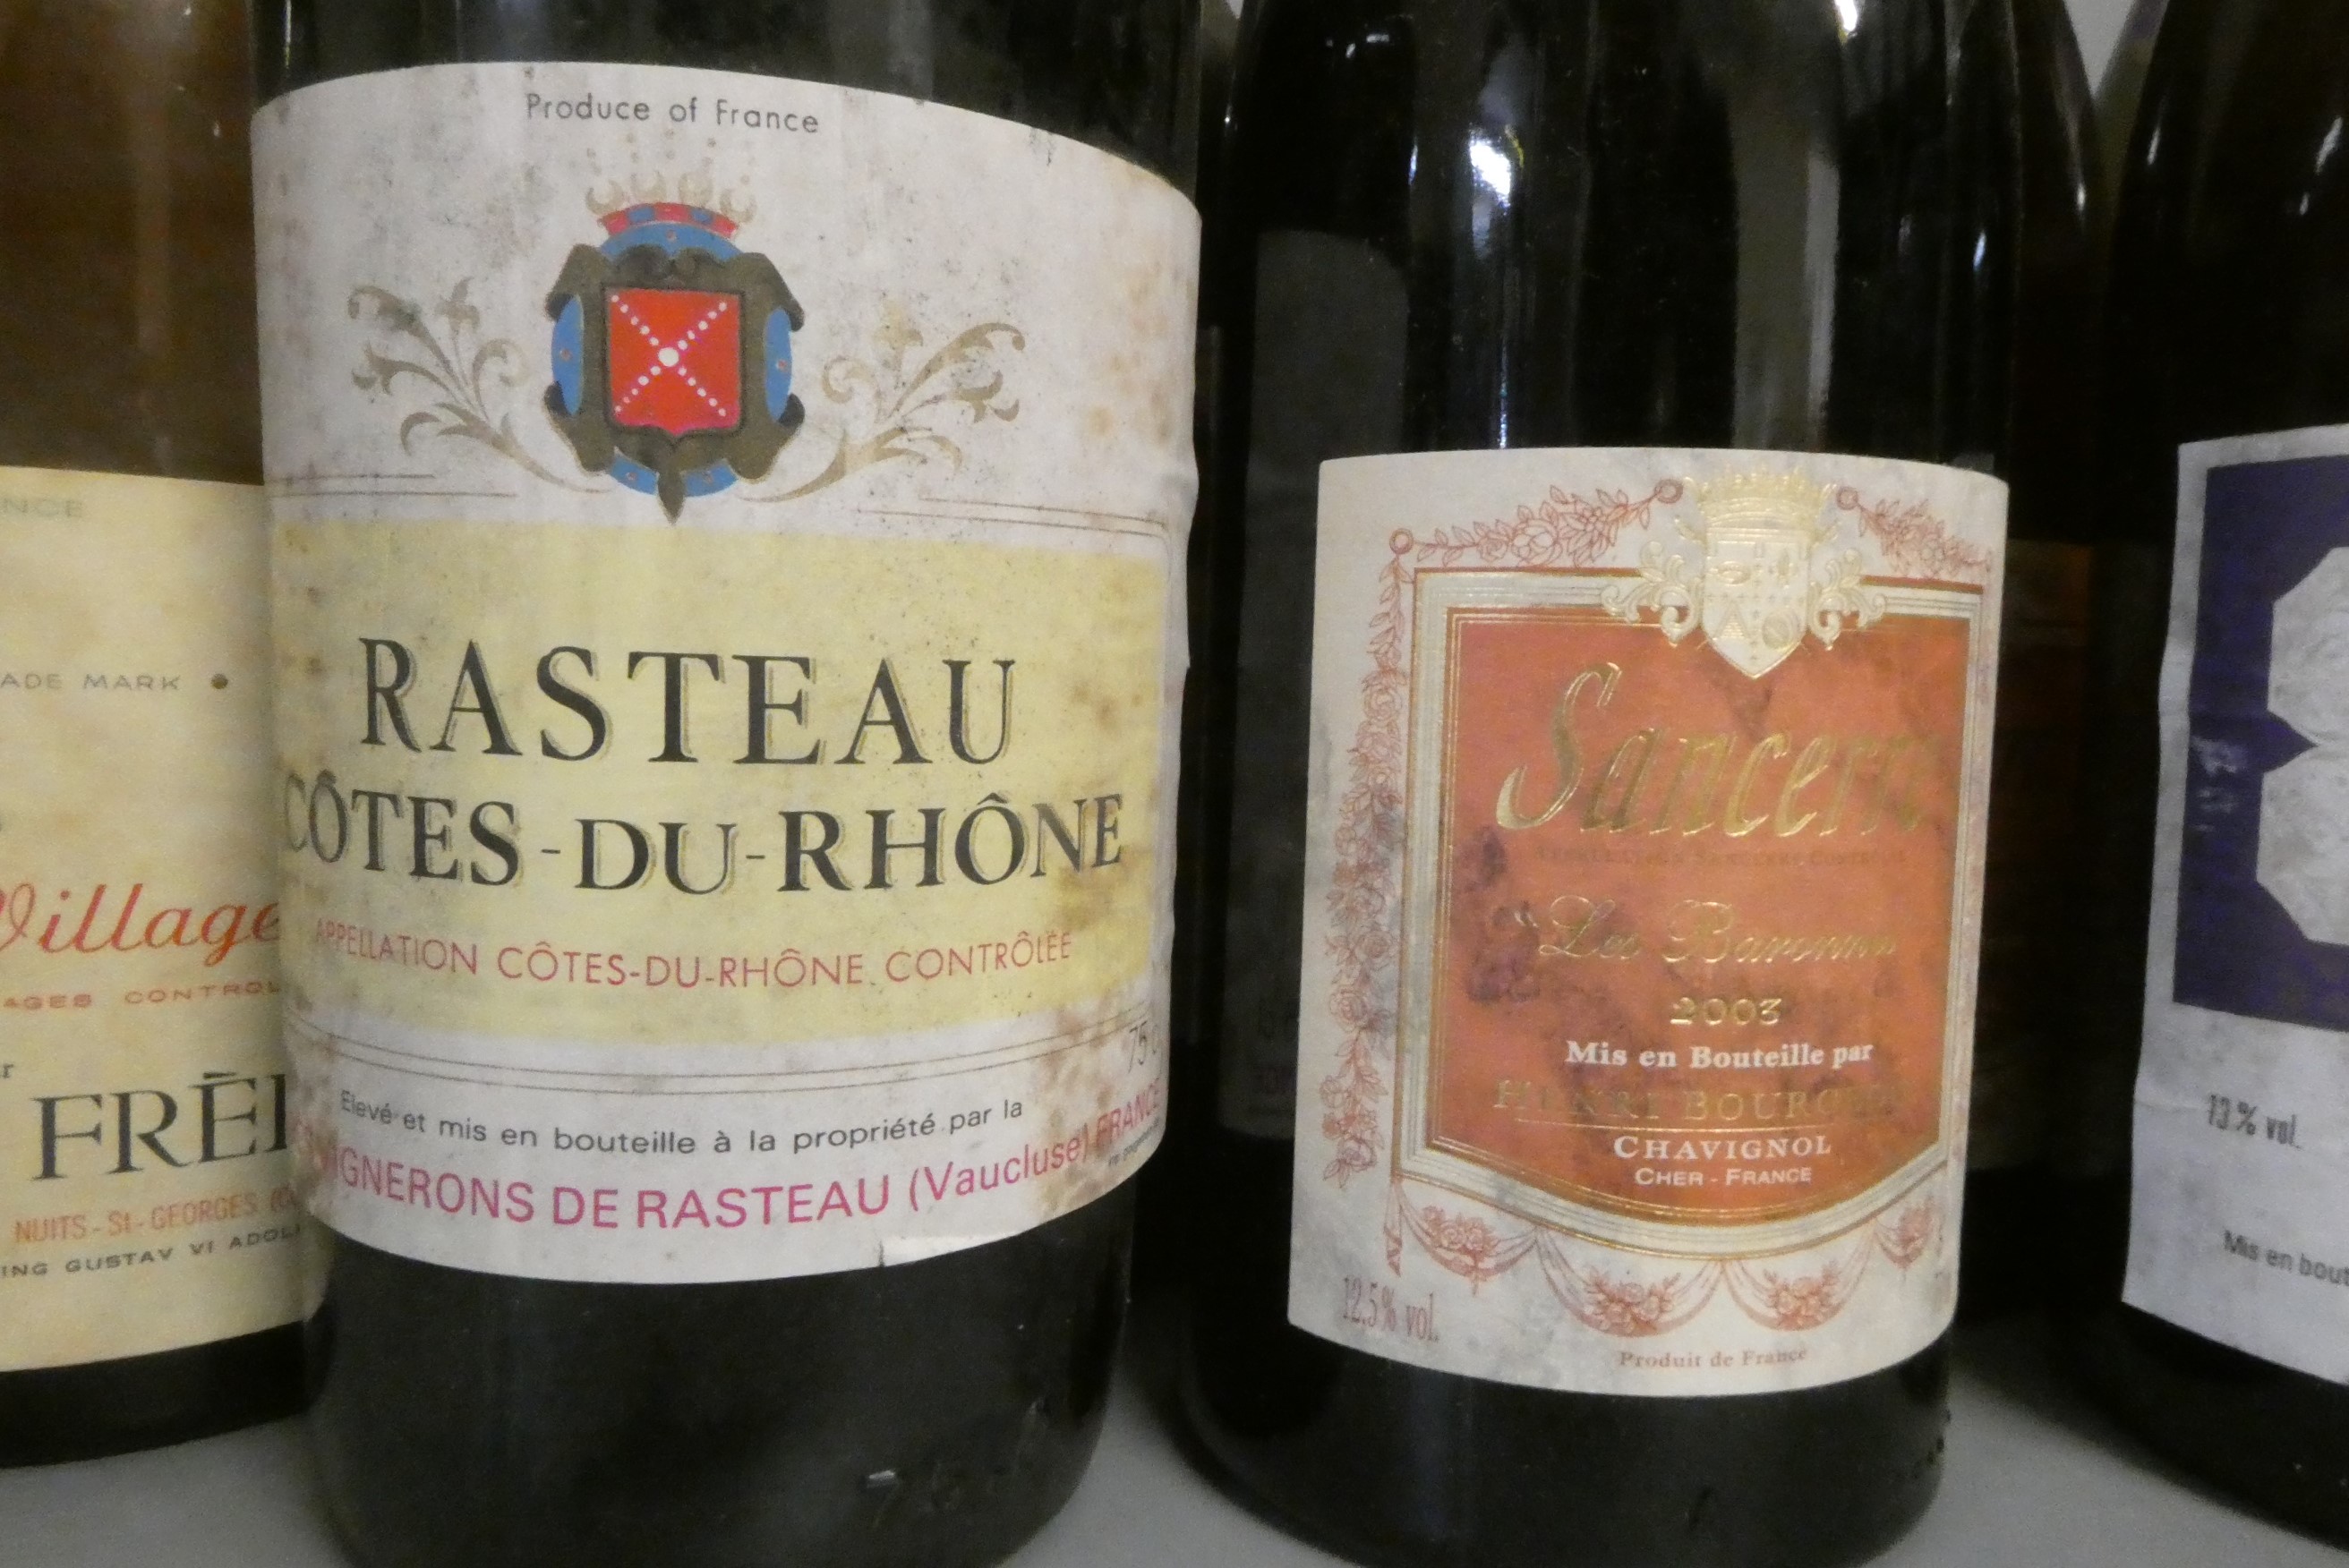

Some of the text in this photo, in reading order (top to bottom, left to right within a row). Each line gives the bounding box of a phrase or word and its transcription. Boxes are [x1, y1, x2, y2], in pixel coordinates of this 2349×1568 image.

[526, 93, 819, 133] Produce of France
[82, 673, 181, 692] MARK
[359, 637, 1015, 766] RASTEAU
[316, 918, 1072, 988] APPELLATION CÔTES-DU-RHÔNE CONTRÔLÉE
[1670, 995, 1783, 1027] 2003
[1566, 1039, 1874, 1070] Mis en Bouteille par
[341, 1089, 1023, 1155] Elevé et mis en bouteille à la propriété par la
[1613, 1134, 1832, 1162] CHAVIGNOL
[552, 1185, 619, 1230] DE
[636, 1172, 889, 1230] RASTEAU
[64, 1247, 174, 1273] GUSTAV
[189, 1240, 215, 1256] VI
[2266, 1248, 2293, 1271] en
[1619, 1346, 1807, 1368] Produit de France
